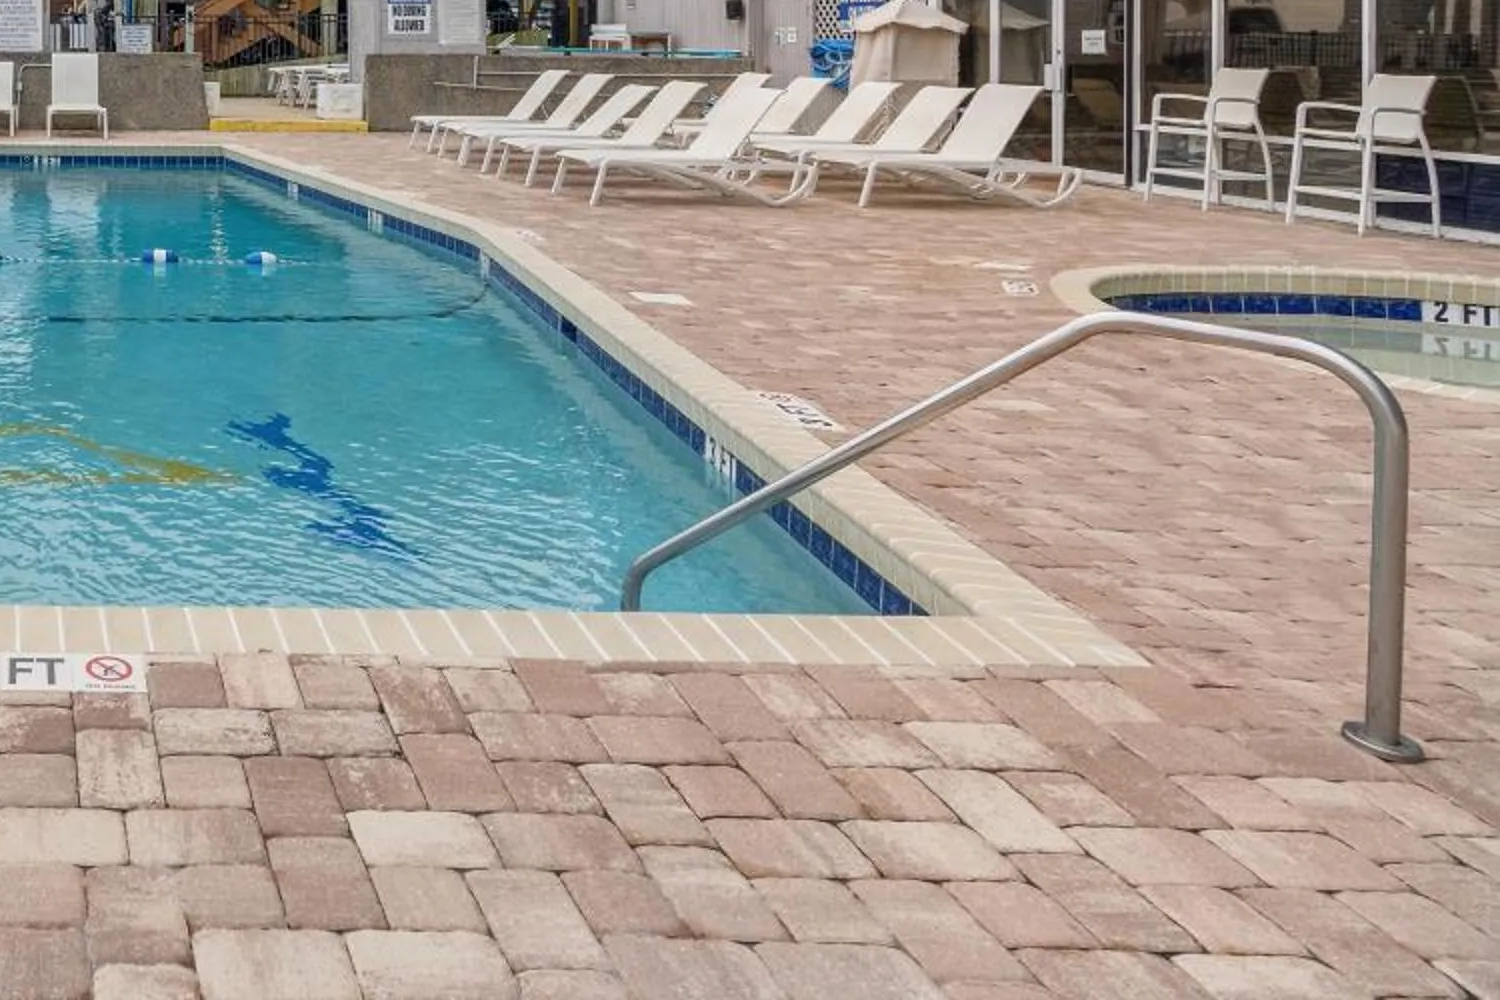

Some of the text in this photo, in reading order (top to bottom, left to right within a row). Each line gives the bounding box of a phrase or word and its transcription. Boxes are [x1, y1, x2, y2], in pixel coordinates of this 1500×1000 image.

[1433, 301, 1497, 326] 2 FT
[8, 657, 65, 685] FT
